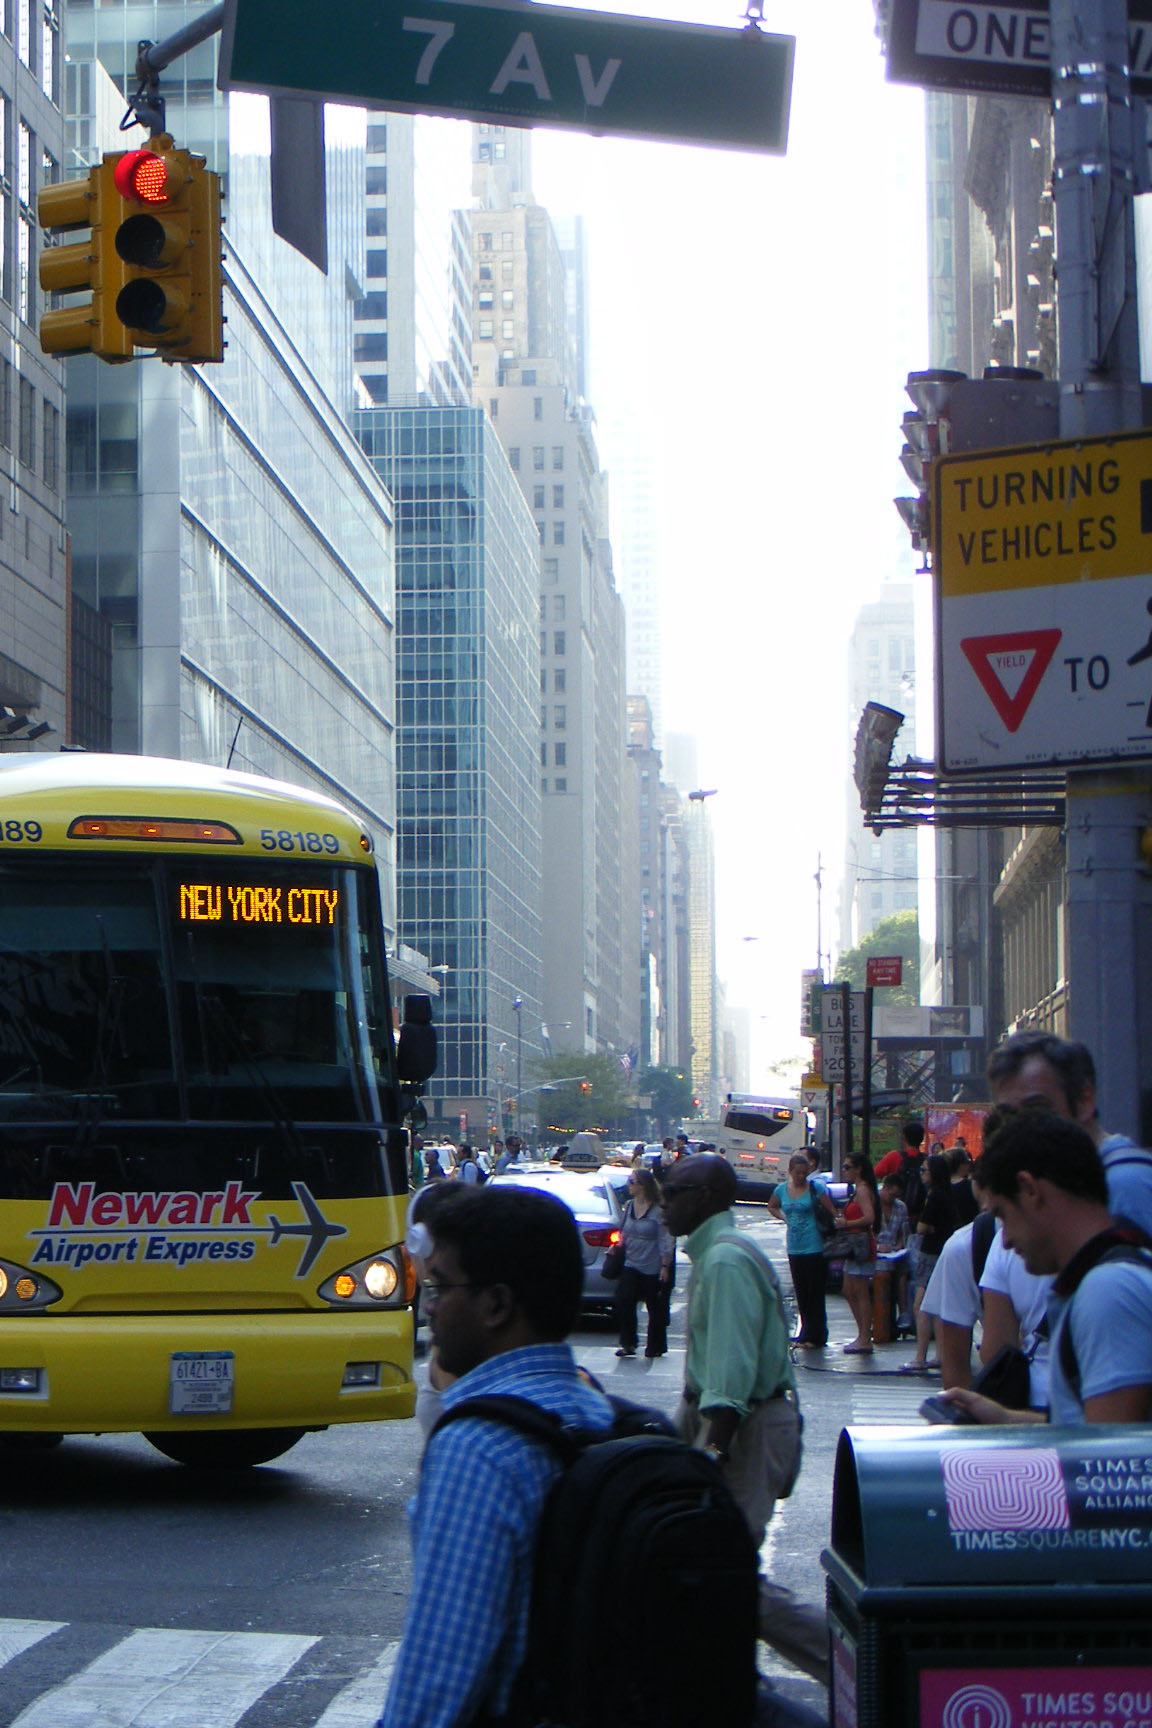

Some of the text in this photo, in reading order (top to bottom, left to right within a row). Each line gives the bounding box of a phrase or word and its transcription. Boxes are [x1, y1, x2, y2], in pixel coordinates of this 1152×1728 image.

[401, 16, 455, 87] 7
[946, 9, 1051, 60] ONE
[952, 459, 1121, 513] TURNING
[957, 515, 1118, 567] VEHICLES
[996, 653, 1110, 693] YIELD TO
[260, 828, 340, 854] 58189
[179, 884, 339, 925] NEW YORK CITY
[48, 1183, 254, 1227] Newark
[32, 1236, 255, 1268] Airport Express
[1020, 1692, 1096, 1716] TIMES
